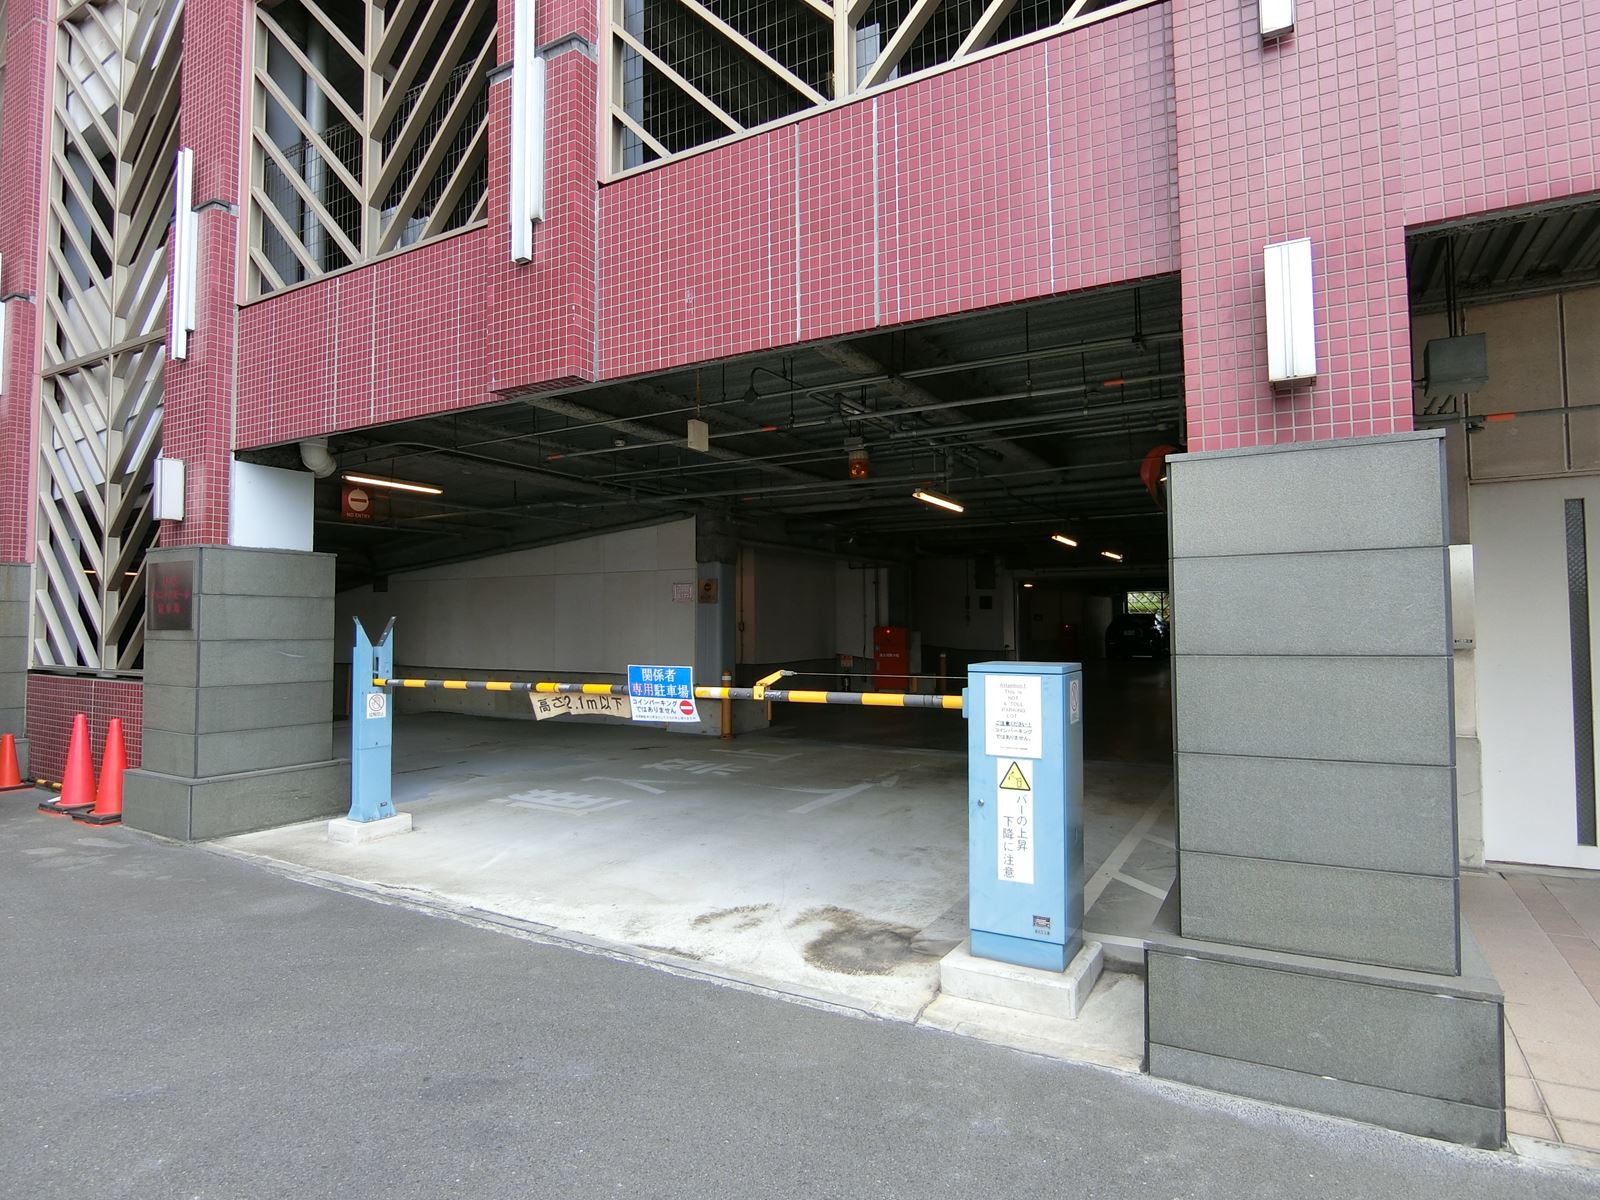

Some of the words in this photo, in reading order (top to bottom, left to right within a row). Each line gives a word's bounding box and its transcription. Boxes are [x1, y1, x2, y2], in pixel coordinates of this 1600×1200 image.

[642, 668, 676, 682] 関係者
[632, 682, 689, 699] 専用駐車場
[538, 695, 622, 714] 高さ2.1m以下
[632, 699, 678, 707] コインパーキング
[637, 706, 677, 714] ではありません
[1016, 794, 1028, 852] バーの上昇
[1003, 815, 1015, 879] 下降に注意
